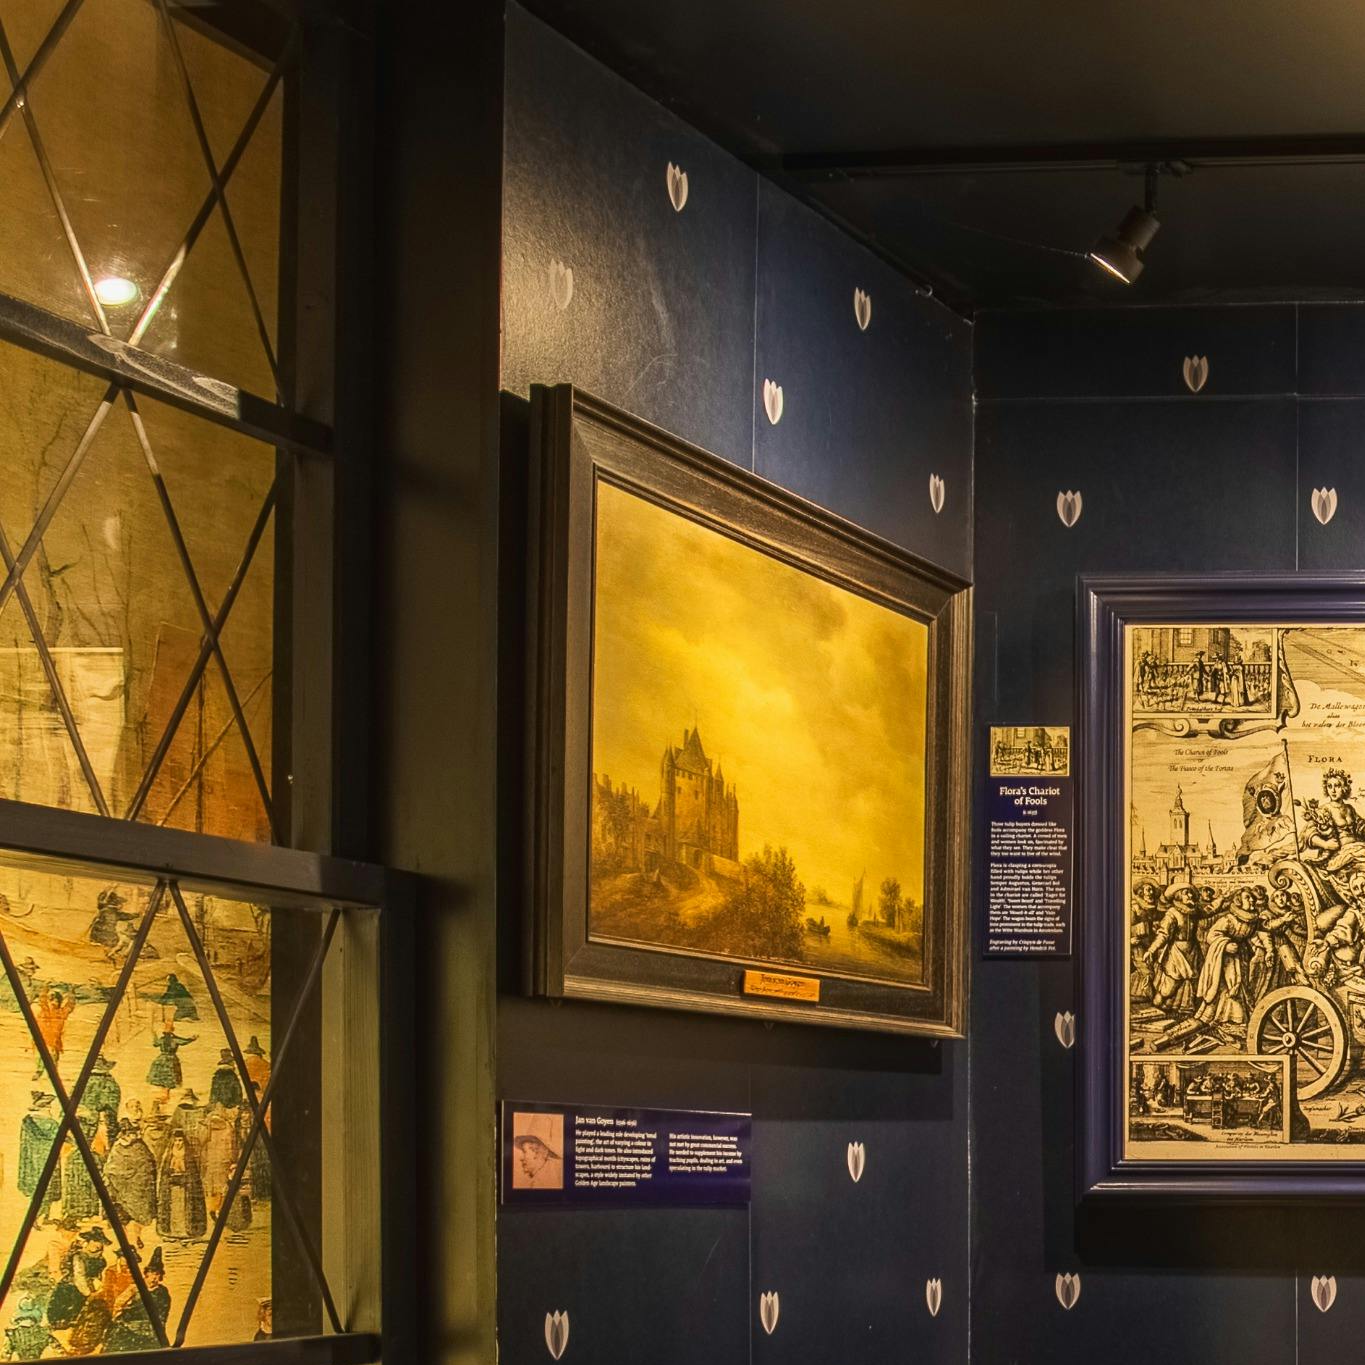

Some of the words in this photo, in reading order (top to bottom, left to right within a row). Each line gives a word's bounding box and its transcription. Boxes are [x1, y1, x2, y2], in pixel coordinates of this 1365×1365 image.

[1000, 787, 1026, 795] Flora's
[1029, 787, 1060, 795] Chariot
[1014, 797, 1023, 805] of
[1026, 797, 1047, 805] Fools
[576, 1116, 585, 1124] Jan
[597, 1117, 614, 1126] Goyen
